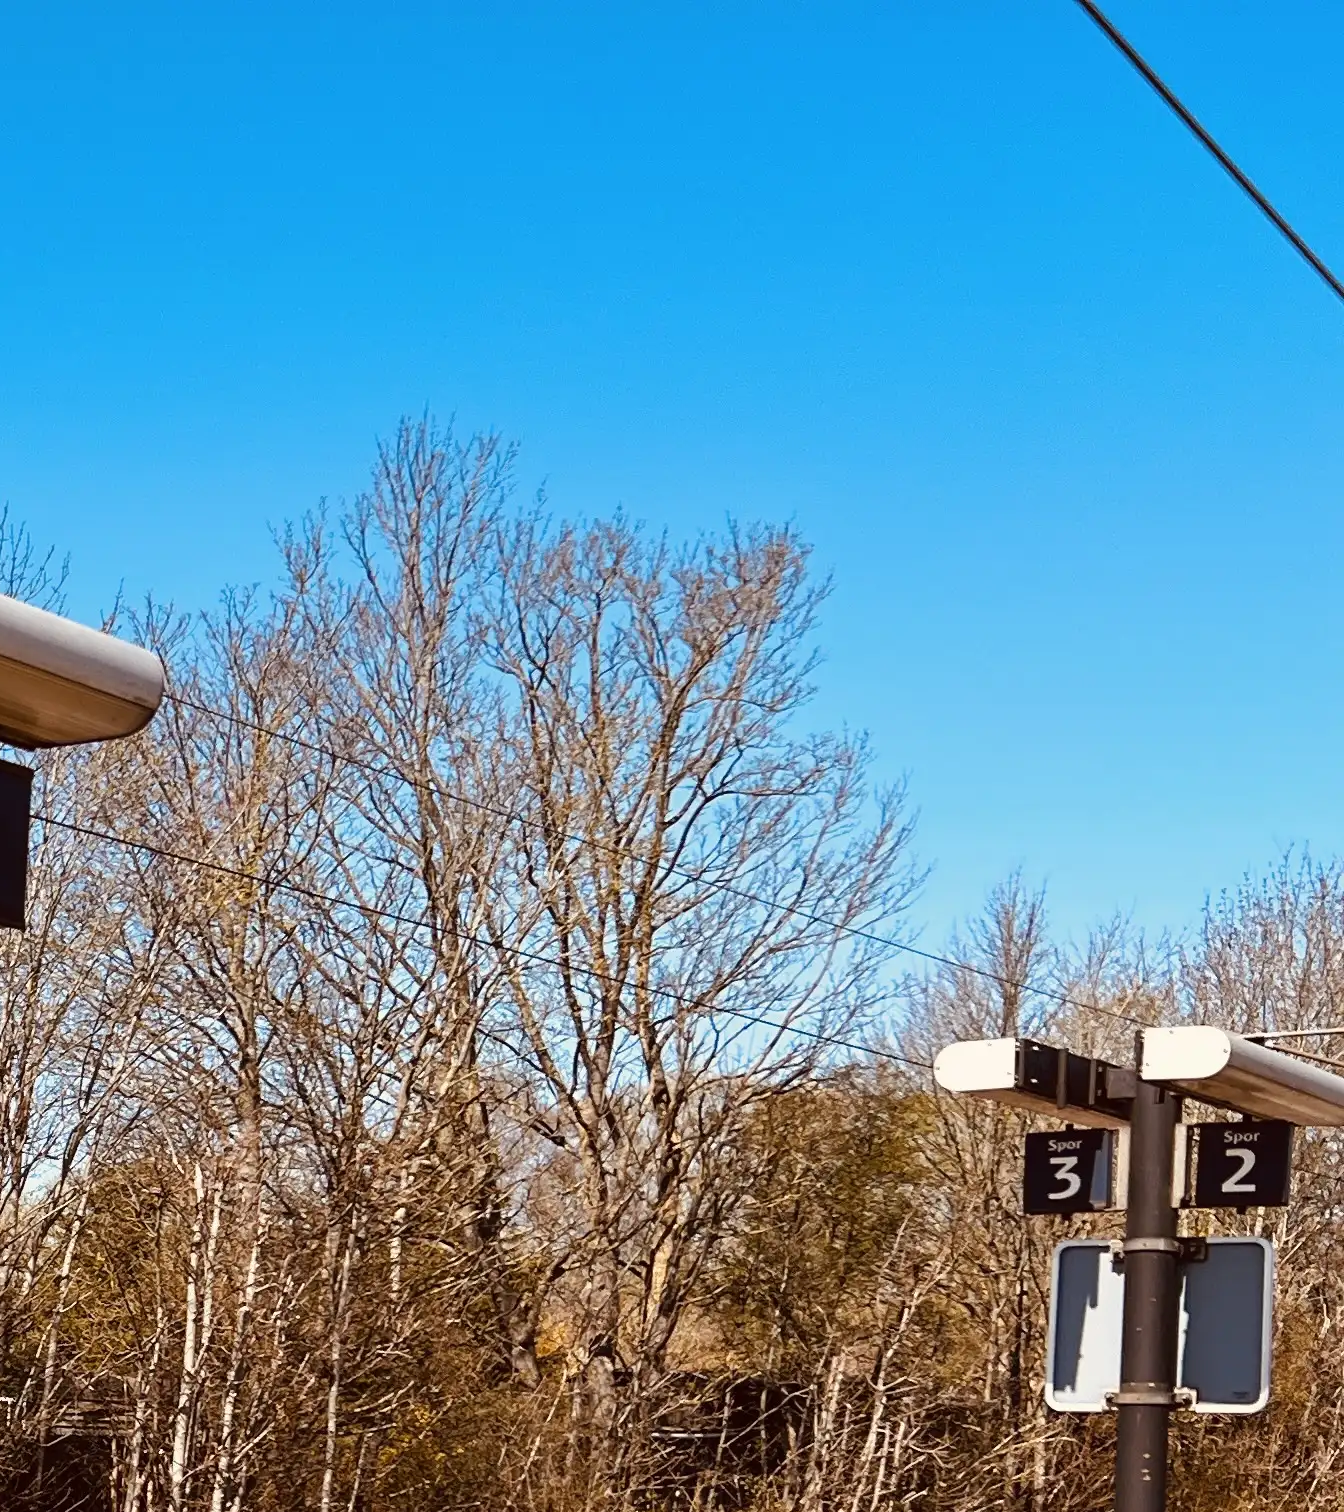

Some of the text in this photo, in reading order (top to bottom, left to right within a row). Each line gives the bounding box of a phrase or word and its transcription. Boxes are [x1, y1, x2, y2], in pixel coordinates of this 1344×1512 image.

[1047, 1138, 1083, 1153] Spor
[1223, 1129, 1261, 1145] Spor
[1047, 1156, 1082, 1200] 3
[1221, 1148, 1257, 1193] 2
